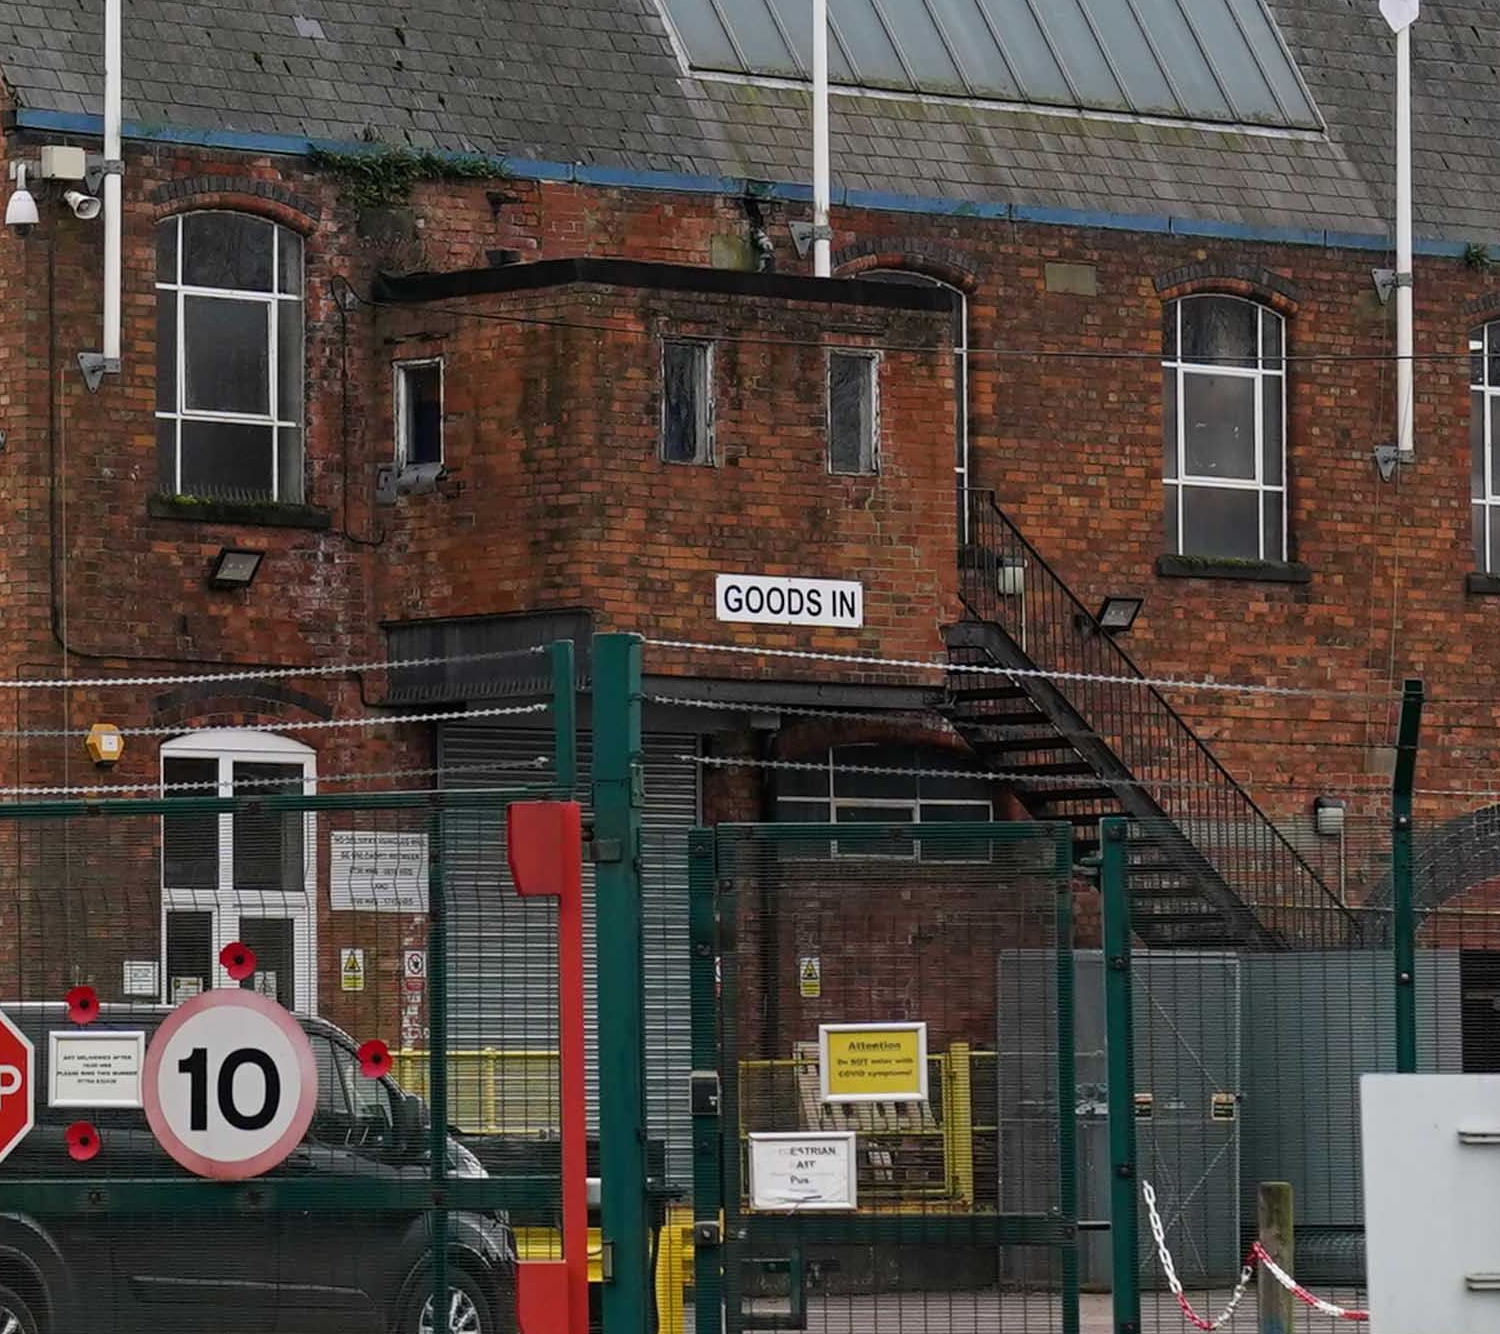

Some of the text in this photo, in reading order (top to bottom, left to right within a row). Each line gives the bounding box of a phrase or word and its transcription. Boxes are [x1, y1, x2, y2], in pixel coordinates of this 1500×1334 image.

[723, 584, 856, 618] GOODS IN
[847, 1041, 902, 1051] Attention
[850, 1058, 868, 1066] NOT
[178, 1047, 281, 1131] 10
[778, 1146, 836, 1156] ESTRIAN
